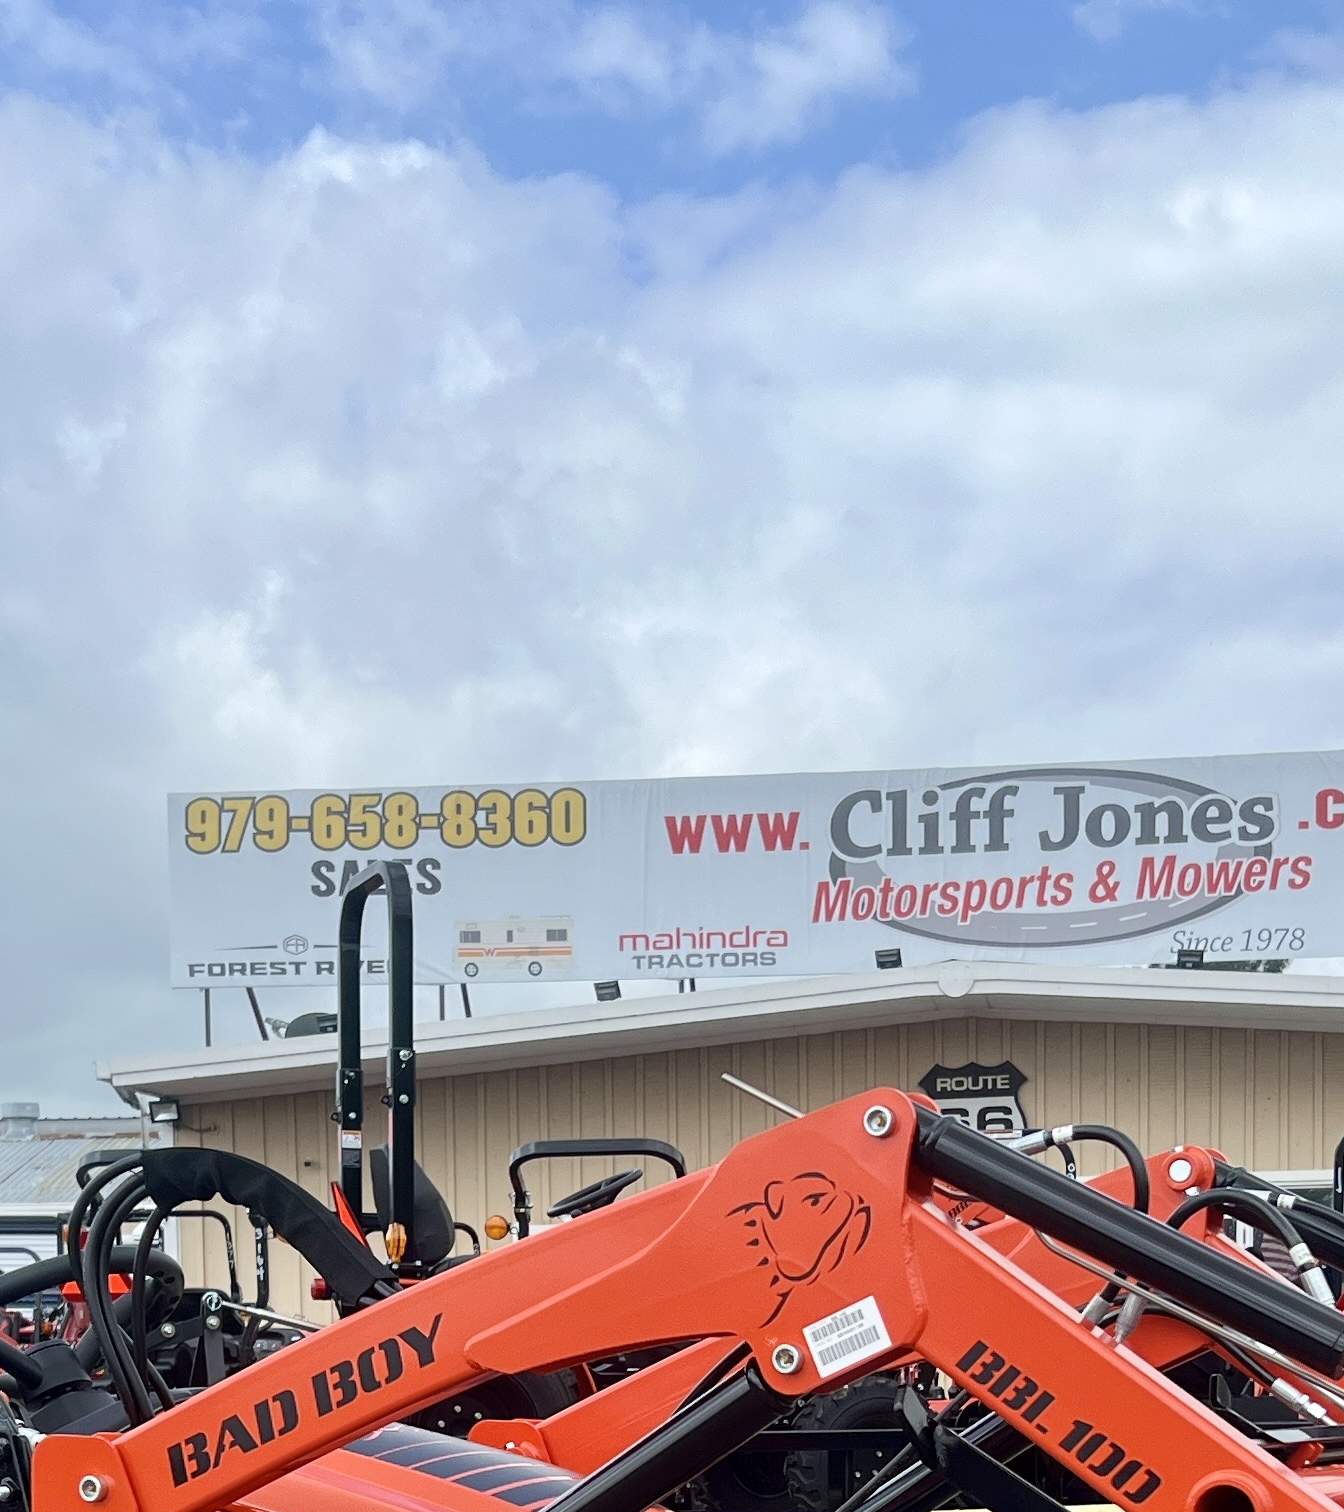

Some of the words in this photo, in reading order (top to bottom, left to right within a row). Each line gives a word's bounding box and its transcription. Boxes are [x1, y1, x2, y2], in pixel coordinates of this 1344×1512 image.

[185, 787, 587, 854] 979-658-8360
[664, 811, 810, 855] WWW.
[830, 785, 1019, 859] Cliff
[1038, 785, 1275, 852] Jones
[811, 865, 1074, 924] Motorsports
[1088, 859, 1120, 903] &
[1135, 853, 1313, 900] Mowers
[618, 925, 789, 952] mahindra
[632, 951, 777, 970] TRACTORS
[1170, 930, 1234, 955] Since
[1239, 927, 1306, 953] 1978
[187, 959, 307, 978] FOREST
[936, 1074, 1011, 1092] ROUTE
[167, 1389, 300, 1488] BAD
[312, 1312, 444, 1418] BOY
[955, 1340, 1056, 1435] BBL
[1058, 1419, 1162, 1505] 100
